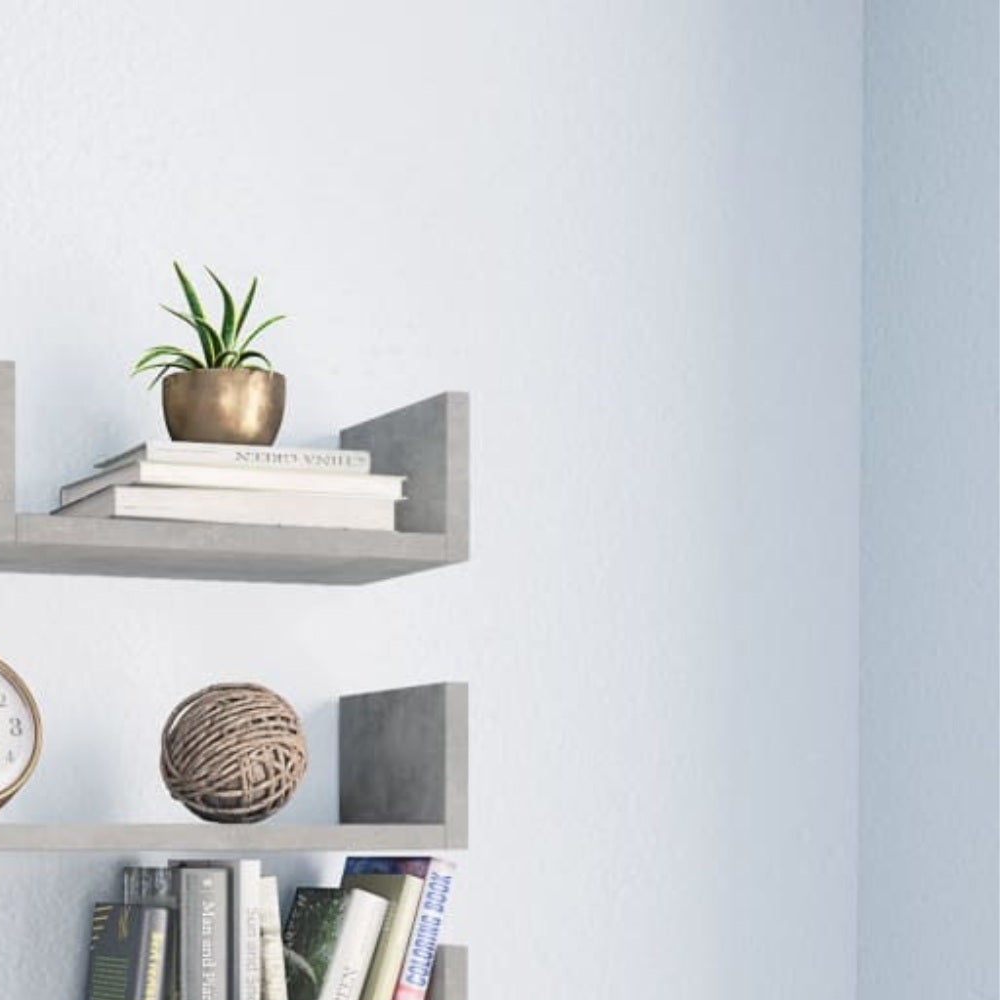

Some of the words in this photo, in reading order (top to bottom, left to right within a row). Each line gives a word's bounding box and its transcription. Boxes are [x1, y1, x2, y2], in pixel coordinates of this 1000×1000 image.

[9, 717, 23, 737] 3
[5, 750, 15, 763] 4
[201, 901, 216, 935] Man
[406, 914, 442, 987] COLORING
[424, 871, 452, 912] BOOK
[201, 938, 217, 968] and
